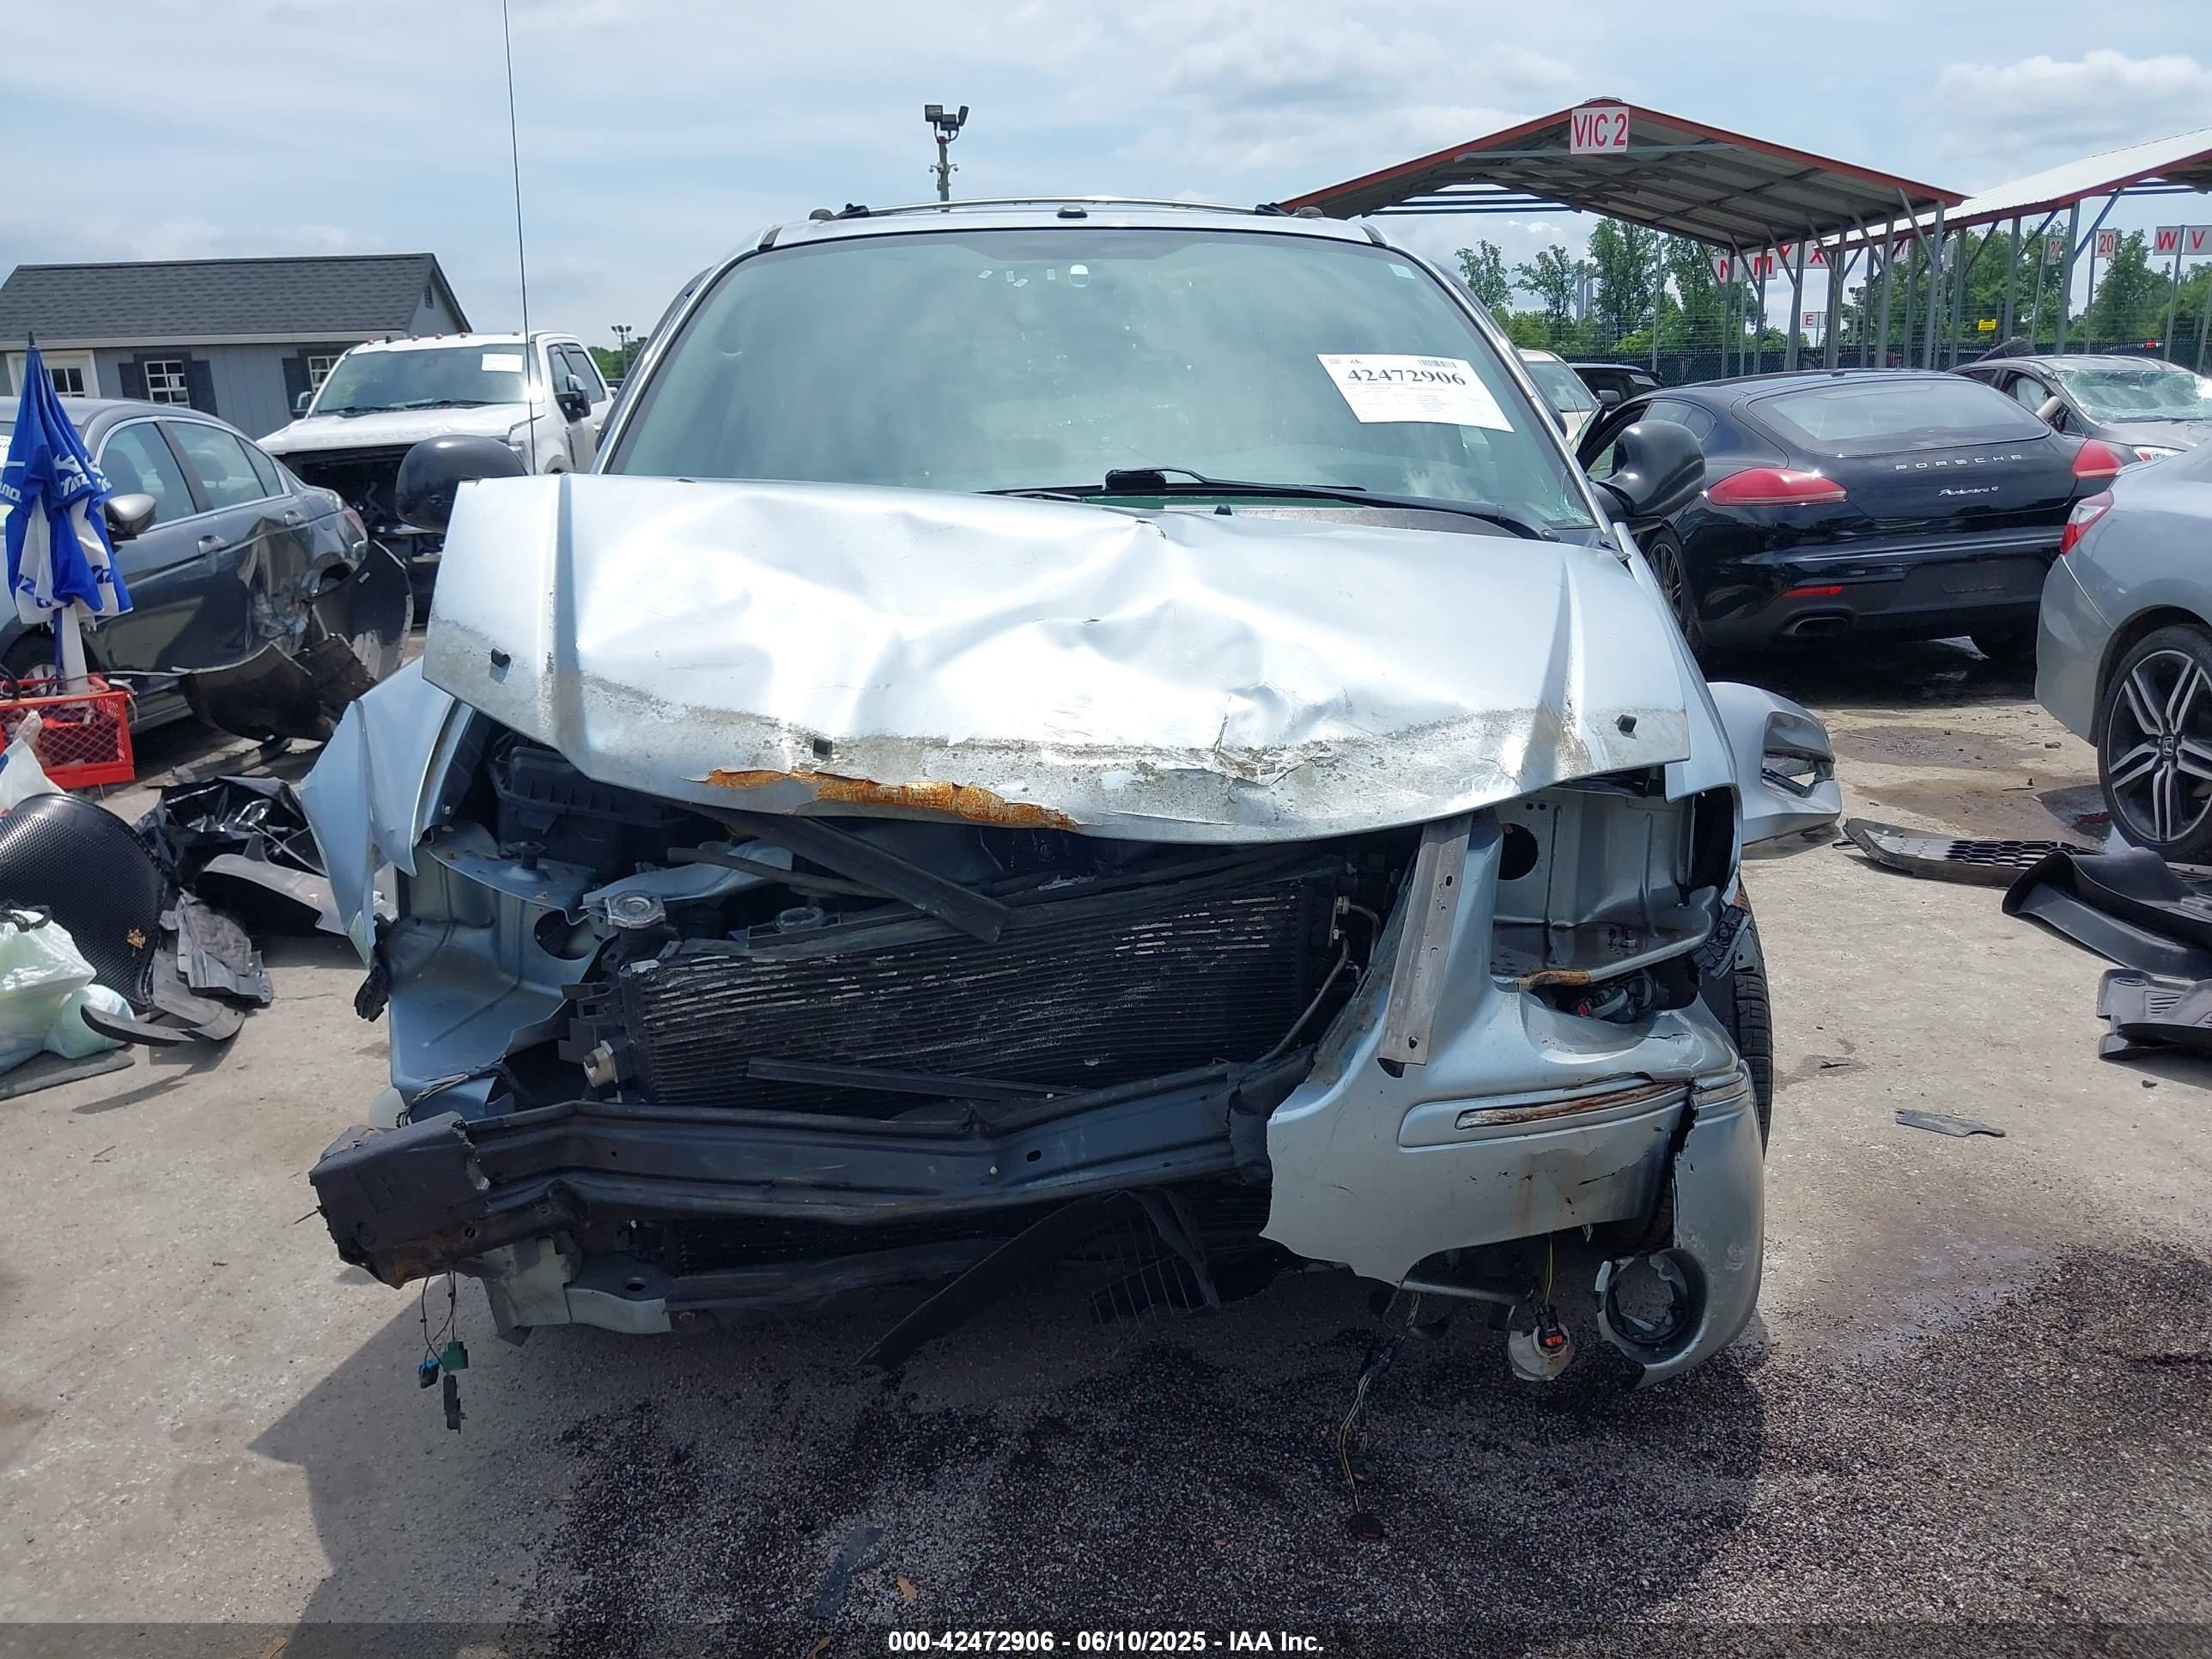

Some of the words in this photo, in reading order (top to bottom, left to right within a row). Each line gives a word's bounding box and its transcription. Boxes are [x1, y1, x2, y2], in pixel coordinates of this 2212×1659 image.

[1573, 113, 1608, 148] VIC
[1613, 112, 1627, 146] 2
[2099, 234, 2113, 252] 20
[2158, 231, 2179, 250] W
[2191, 231, 2206, 249] V
[1805, 314, 1814, 325] E
[1347, 368, 1467, 386] 42472906
[1895, 454, 2023, 471] PORSCHE
